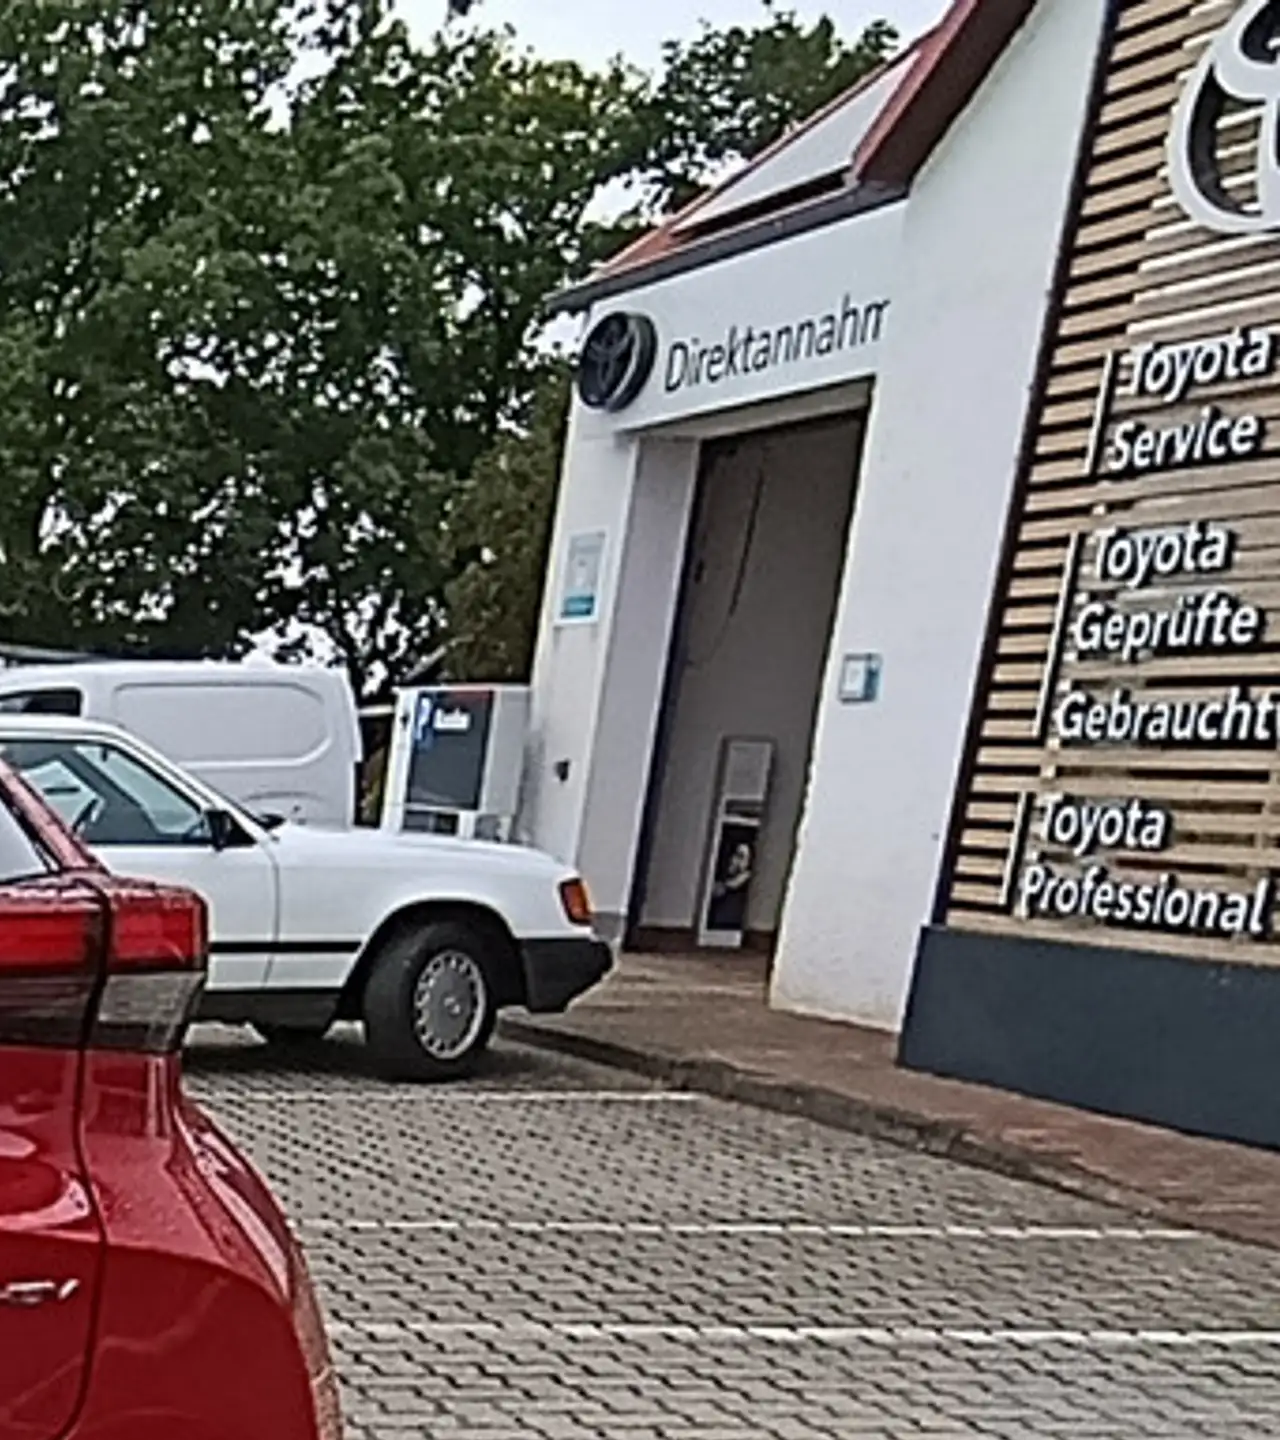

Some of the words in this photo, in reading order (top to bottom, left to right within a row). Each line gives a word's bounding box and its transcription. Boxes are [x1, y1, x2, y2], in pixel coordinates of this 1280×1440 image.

[1129, 326, 1270, 402] Toyota
[1107, 405, 1258, 470] Service
[1093, 520, 1228, 587] Toyota
[1073, 592, 1259, 661] Geprüfte
[1054, 686, 1280, 741] Gebraucht
[1039, 792, 1165, 856] Toyota
[1018, 866, 1269, 934] Professional
